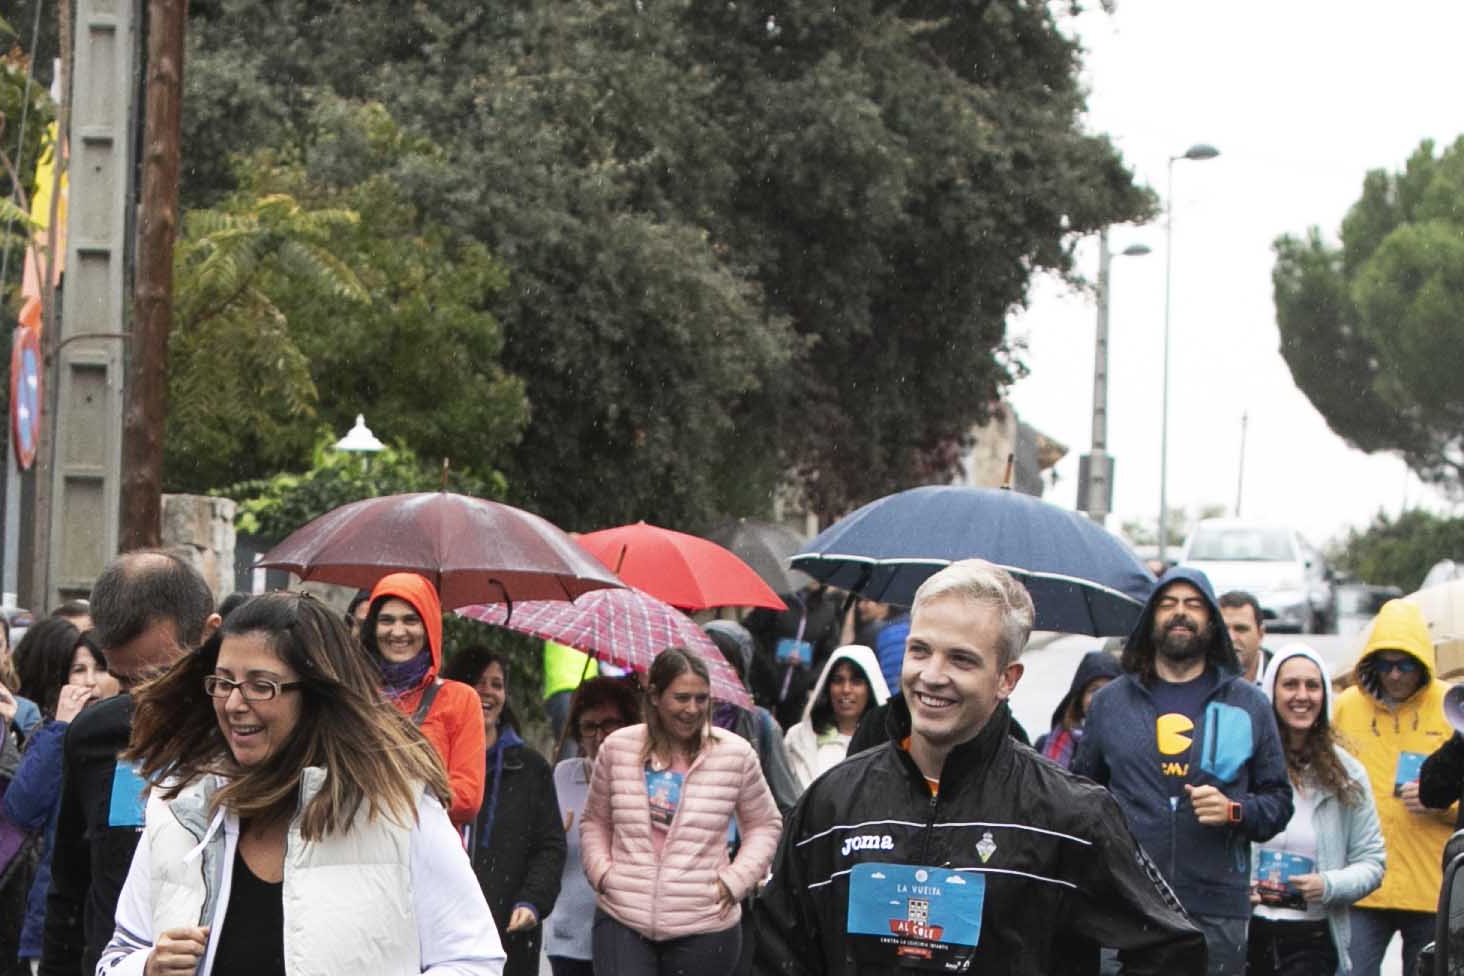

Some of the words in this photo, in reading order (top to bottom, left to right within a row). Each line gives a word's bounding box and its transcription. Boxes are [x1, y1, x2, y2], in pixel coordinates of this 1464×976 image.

[897, 883, 908, 894] LA
[912, 885, 942, 897] VUELTA
[898, 921, 909, 932] AL
